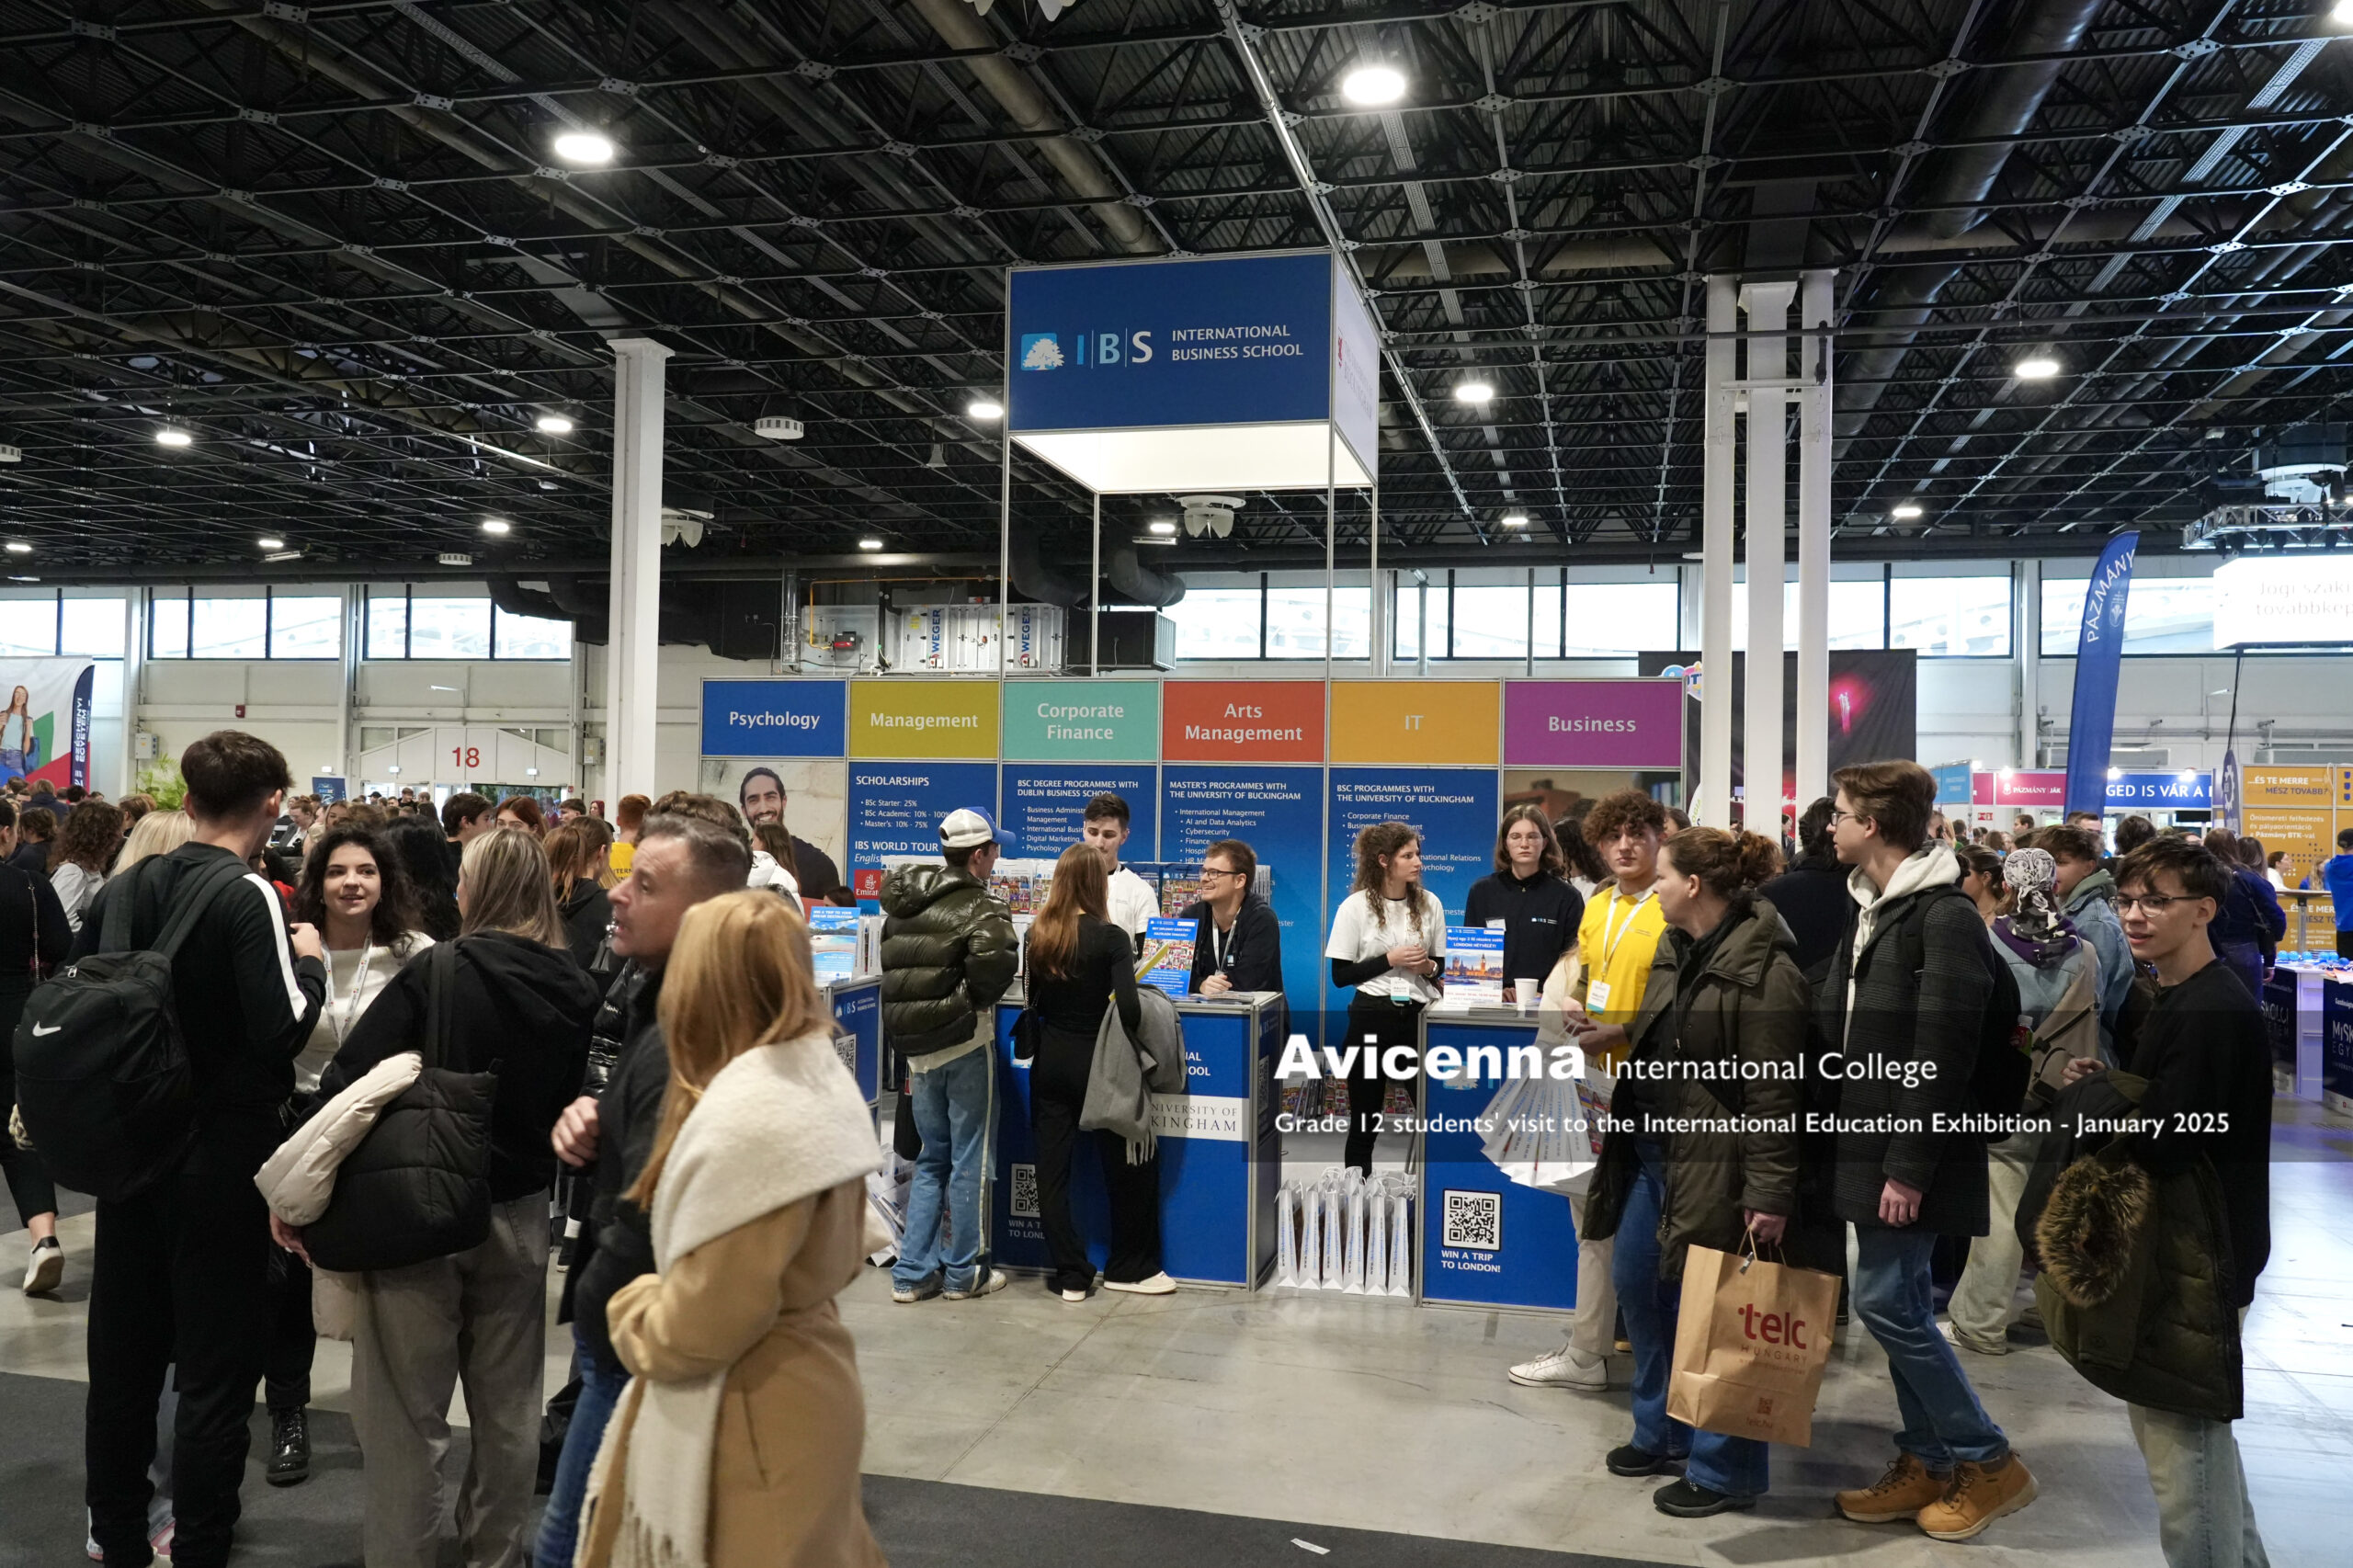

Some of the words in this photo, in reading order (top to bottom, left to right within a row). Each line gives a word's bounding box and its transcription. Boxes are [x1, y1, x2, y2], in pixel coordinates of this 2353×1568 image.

[1171, 324, 1290, 343] INTERNATIONAL
[1171, 346, 1238, 362] BUSINESS
[1242, 343, 1304, 358] SCHOOL
[2086, 548, 2137, 643] PÁZMÁNY
[930, 608, 941, 653] WEGER
[1037, 702, 1125, 721] Corporate
[1223, 702, 1263, 719] Arts
[729, 711, 821, 730] Psychology
[870, 712, 979, 731] Management
[1404, 715, 1425, 731] IT
[1549, 716, 1636, 732] Business
[1047, 724, 1114, 740] Finance
[1185, 725, 1302, 744] Management
[451, 747, 481, 768] 18
[856, 776, 930, 787] SCHOLARSHIPS
[1063, 780, 1117, 789] PROGRAMMES
[1209, 781, 1264, 790] PROGRAMMES
[1266, 782, 1287, 790] WITH
[2266, 777, 2278, 785] TE
[2279, 777, 2309, 786] MERRE
[1169, 790, 1185, 799] THE
[1234, 791, 1245, 800] OF
[1354, 785, 1411, 793] PROGRAMMES
[2013, 786, 2047, 794] PÁZMÁNY
[2142, 785, 2155, 797] IS
[2159, 782, 2189, 798] VÁR
[2192, 784, 2204, 798] A
[2265, 787, 2289, 795] MÉSZ
[878, 799, 902, 807] Starter:
[1404, 795, 1416, 803] OF
[878, 810, 912, 818] Academic:
[1222, 809, 1266, 817] Management
[1209, 818, 1224, 826] Data
[1226, 819, 1256, 827] Analytics
[1185, 828, 1230, 836] Cybersecurity
[855, 841, 870, 850] IBS
[871, 841, 908, 851] WORLD
[910, 842, 938, 852] TOUR
[1222, 1107, 1237, 1117] OF
[1151, 1115, 1236, 1132] KINGHAM
[1008, 1219, 1025, 1228] WIN
[1026, 1220, 1034, 1228] A
[1008, 1229, 1020, 1238] TO
[1440, 1250, 1460, 1261] WIN
[1461, 1251, 1470, 1261] A
[1472, 1252, 1494, 1262] TRIP
[1440, 1260, 1453, 1271] TO
[1456, 1261, 1501, 1274] LONDON!
[1737, 1303, 1807, 1350] telc
[1740, 1344, 1808, 1365] HUNGARY
